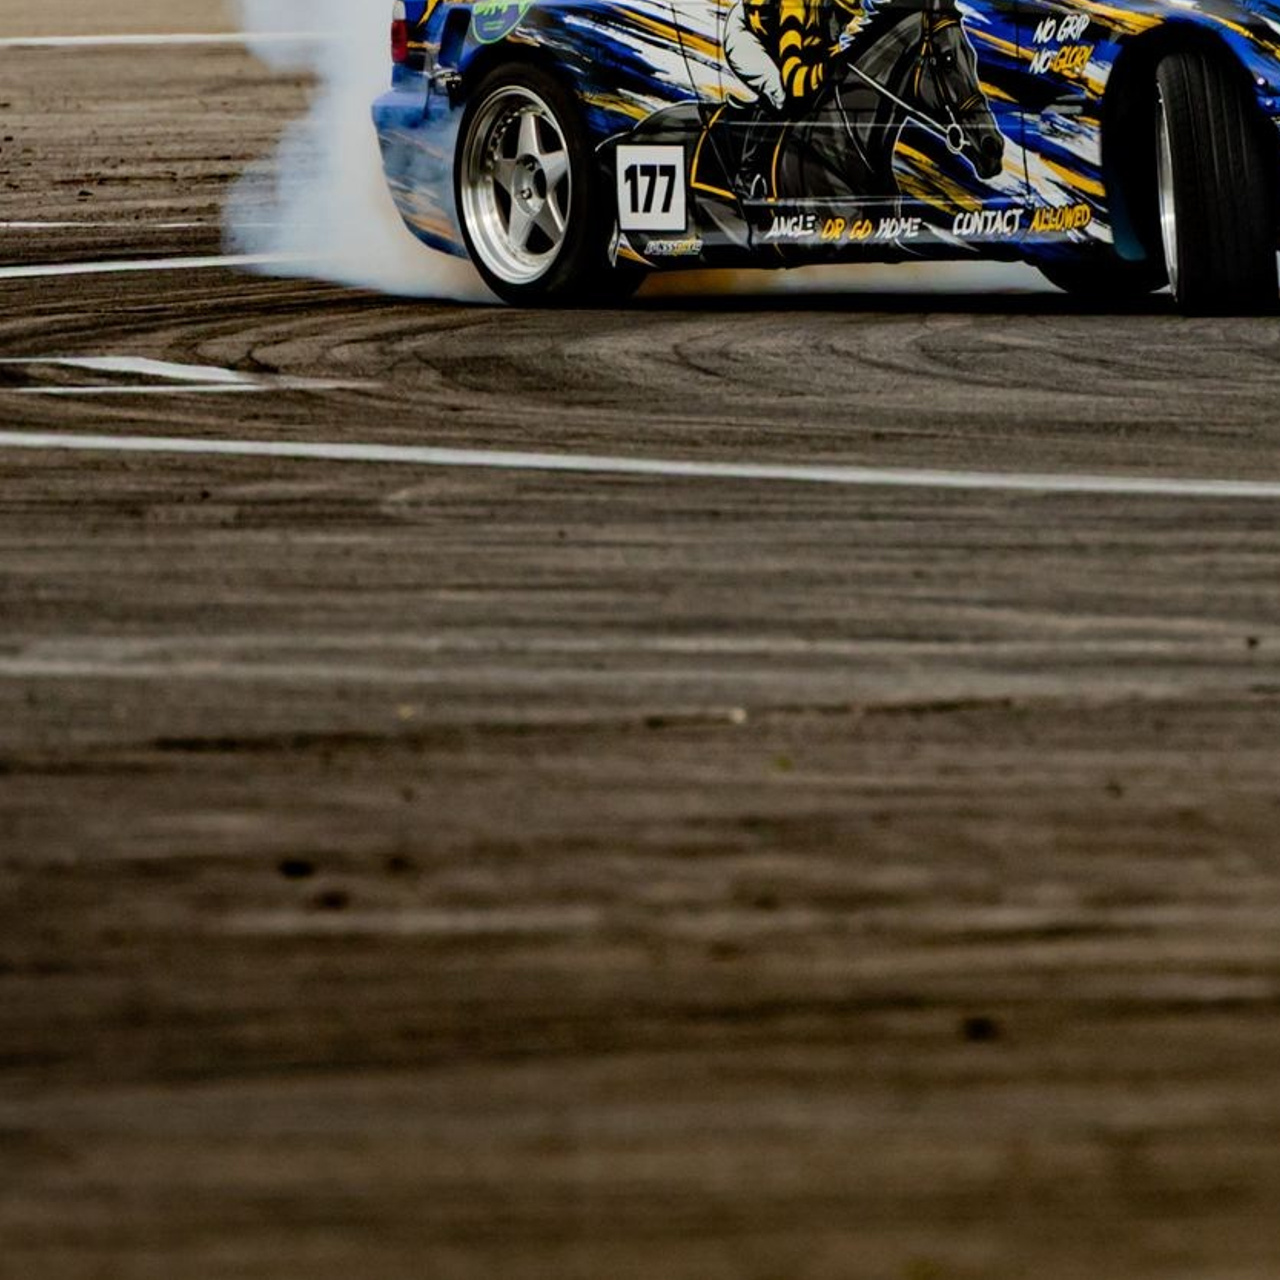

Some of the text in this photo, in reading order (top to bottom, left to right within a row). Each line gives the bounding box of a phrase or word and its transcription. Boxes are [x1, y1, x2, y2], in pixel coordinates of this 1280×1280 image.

[1032, 13, 1091, 44] NO GRIP
[1029, 45, 1095, 74] NO GLORY
[624, 164, 676, 213] 177
[764, 215, 922, 241] ANGLE OR GO HOME
[952, 203, 1091, 236] CONTACT ALLOWED
